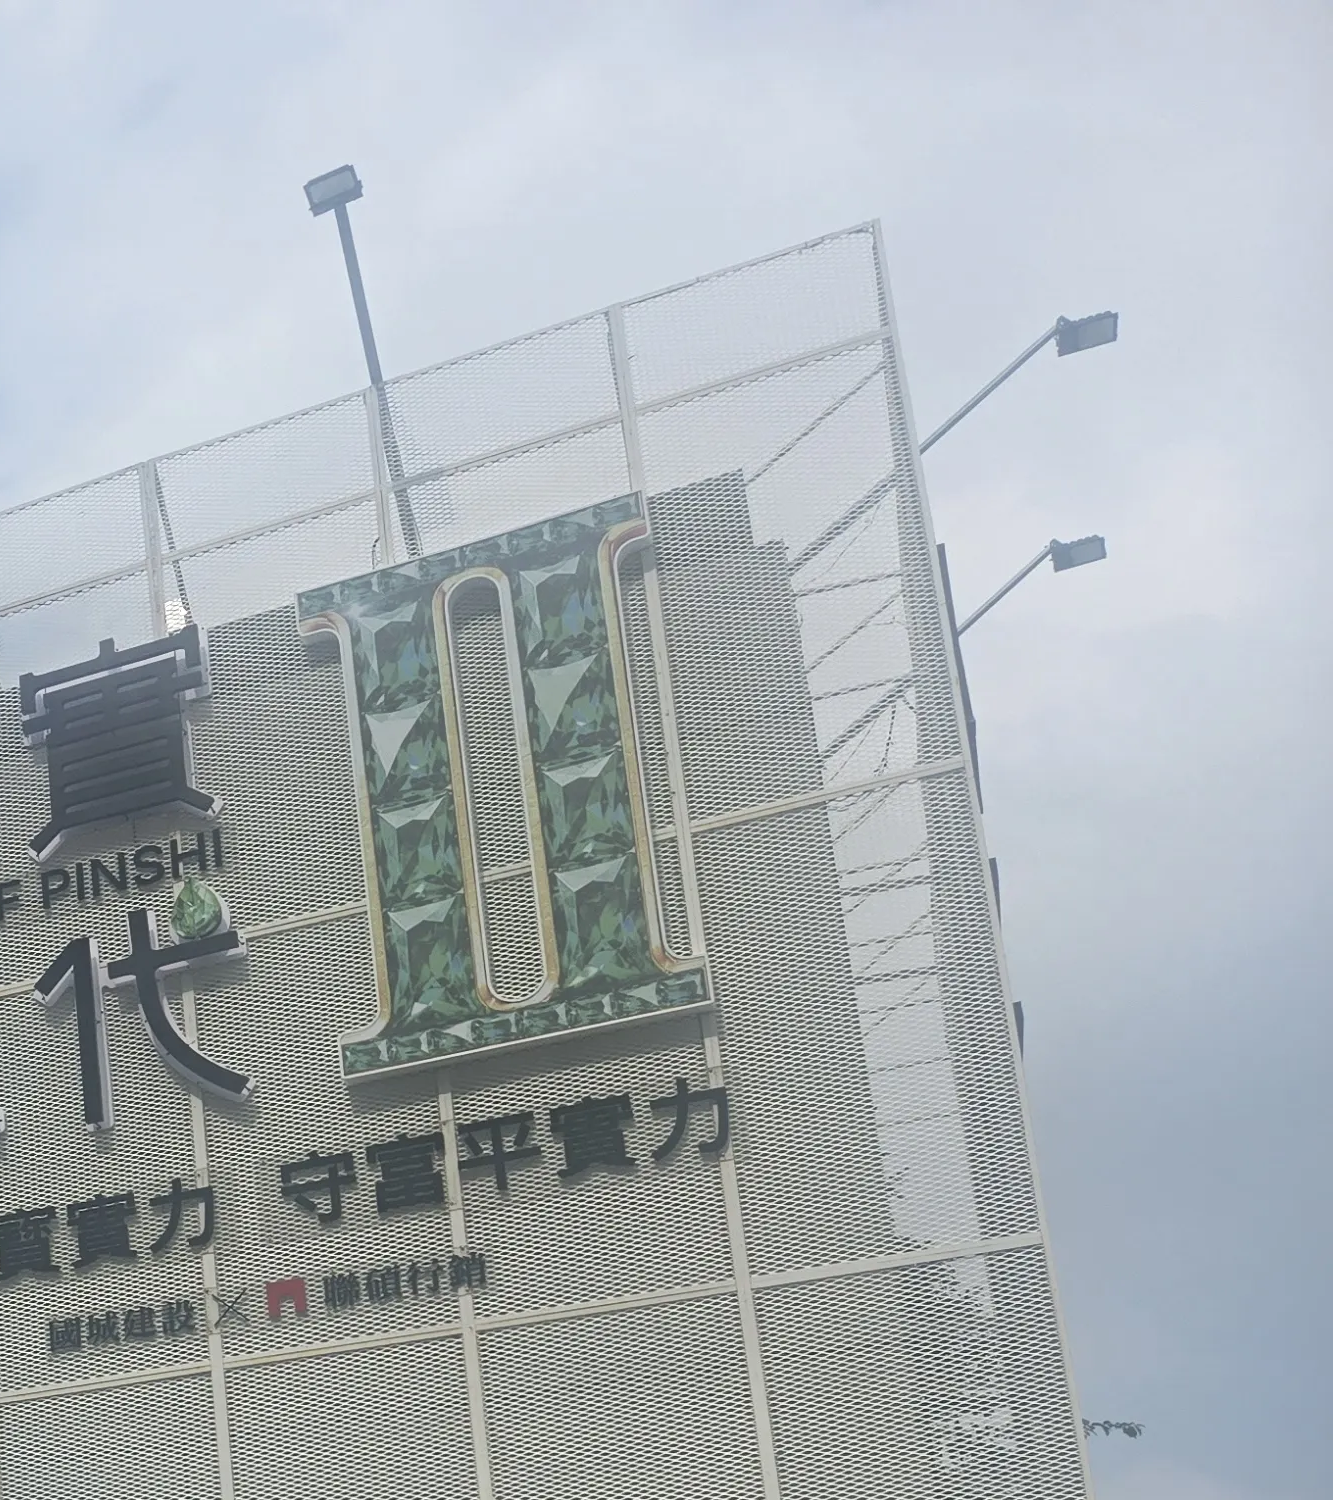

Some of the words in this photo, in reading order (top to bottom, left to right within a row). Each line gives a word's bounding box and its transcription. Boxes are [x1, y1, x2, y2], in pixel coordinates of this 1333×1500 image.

[41, 828, 224, 910] PINSHI
[280, 1076, 729, 1223] 守富平實力
[48, 1300, 195, 1354] 國城建設
